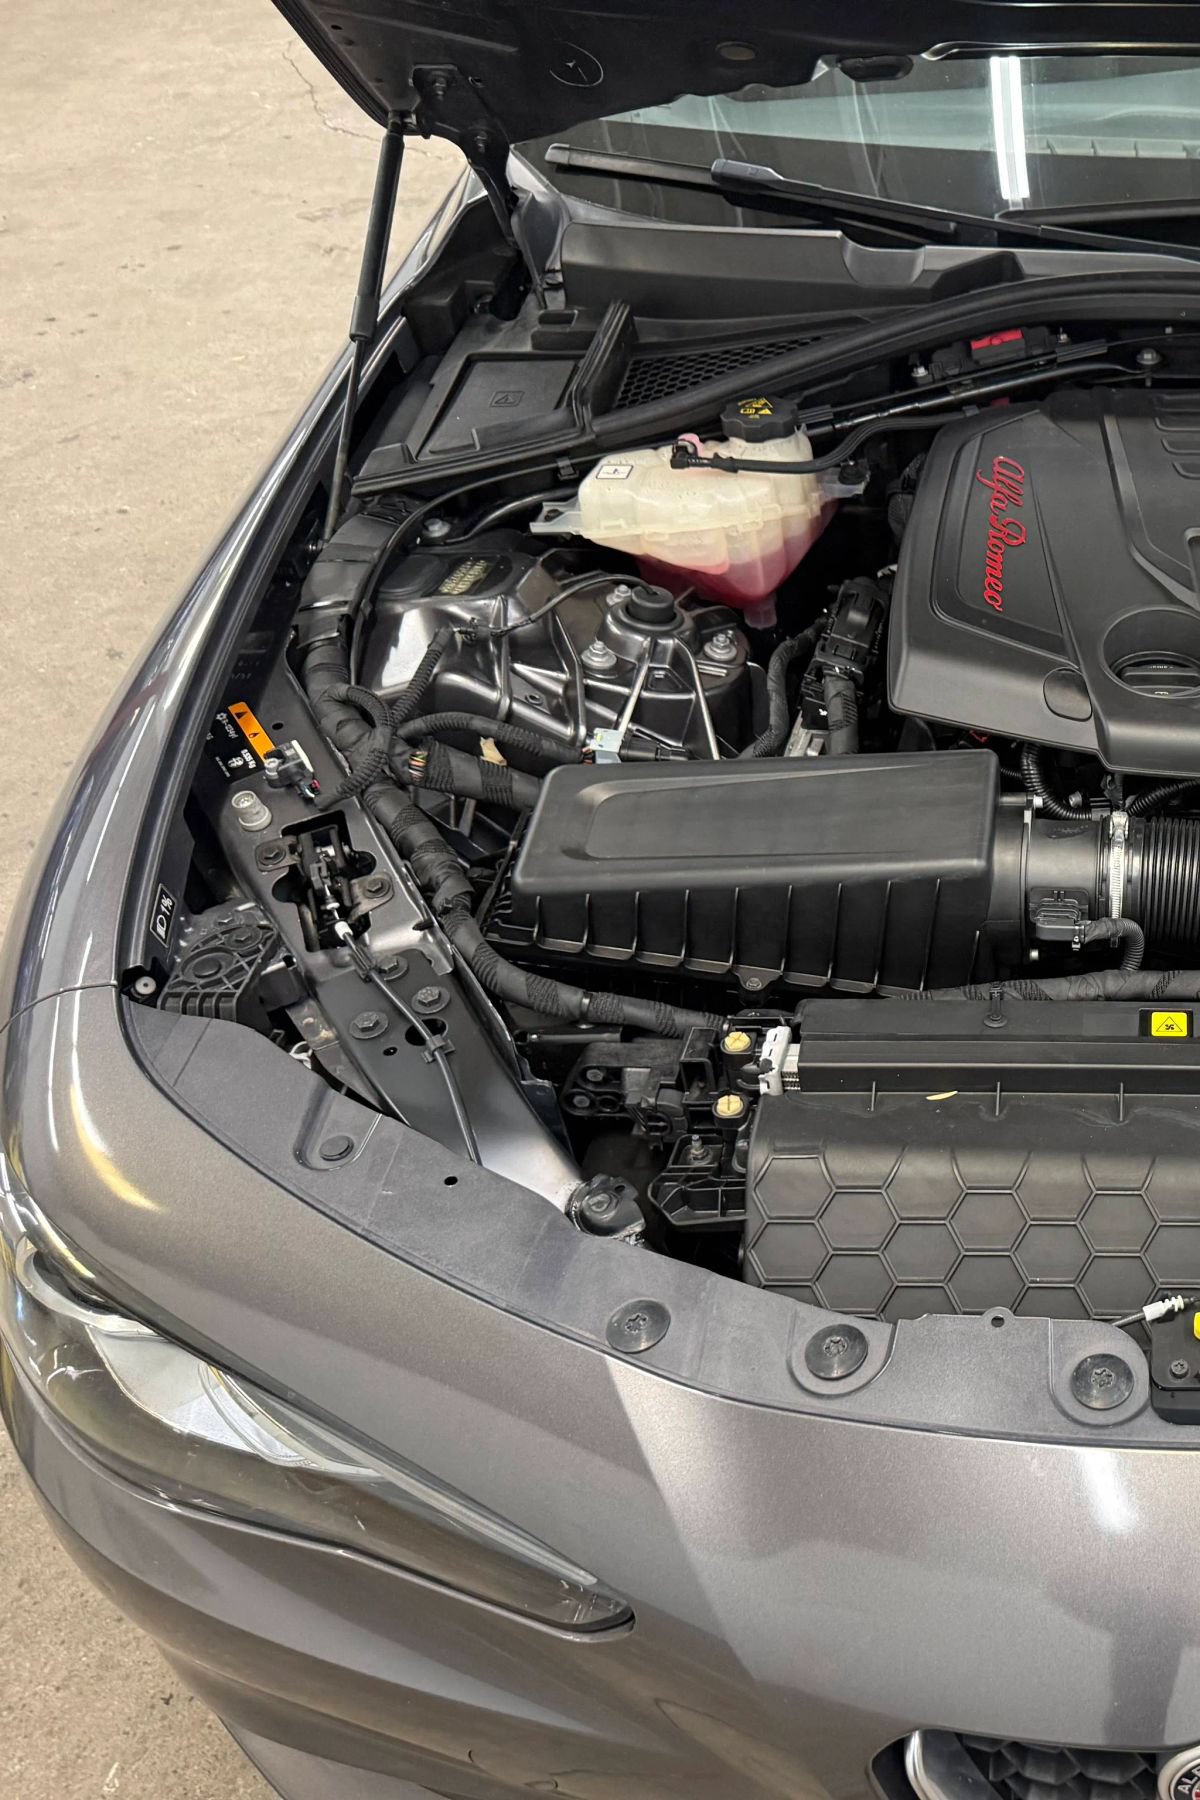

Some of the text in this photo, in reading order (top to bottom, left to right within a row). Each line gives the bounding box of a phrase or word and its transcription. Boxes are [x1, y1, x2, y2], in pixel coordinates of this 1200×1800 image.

[976, 456, 1027, 612] Alfa Romeo
[160, 894, 173, 916] 1%
